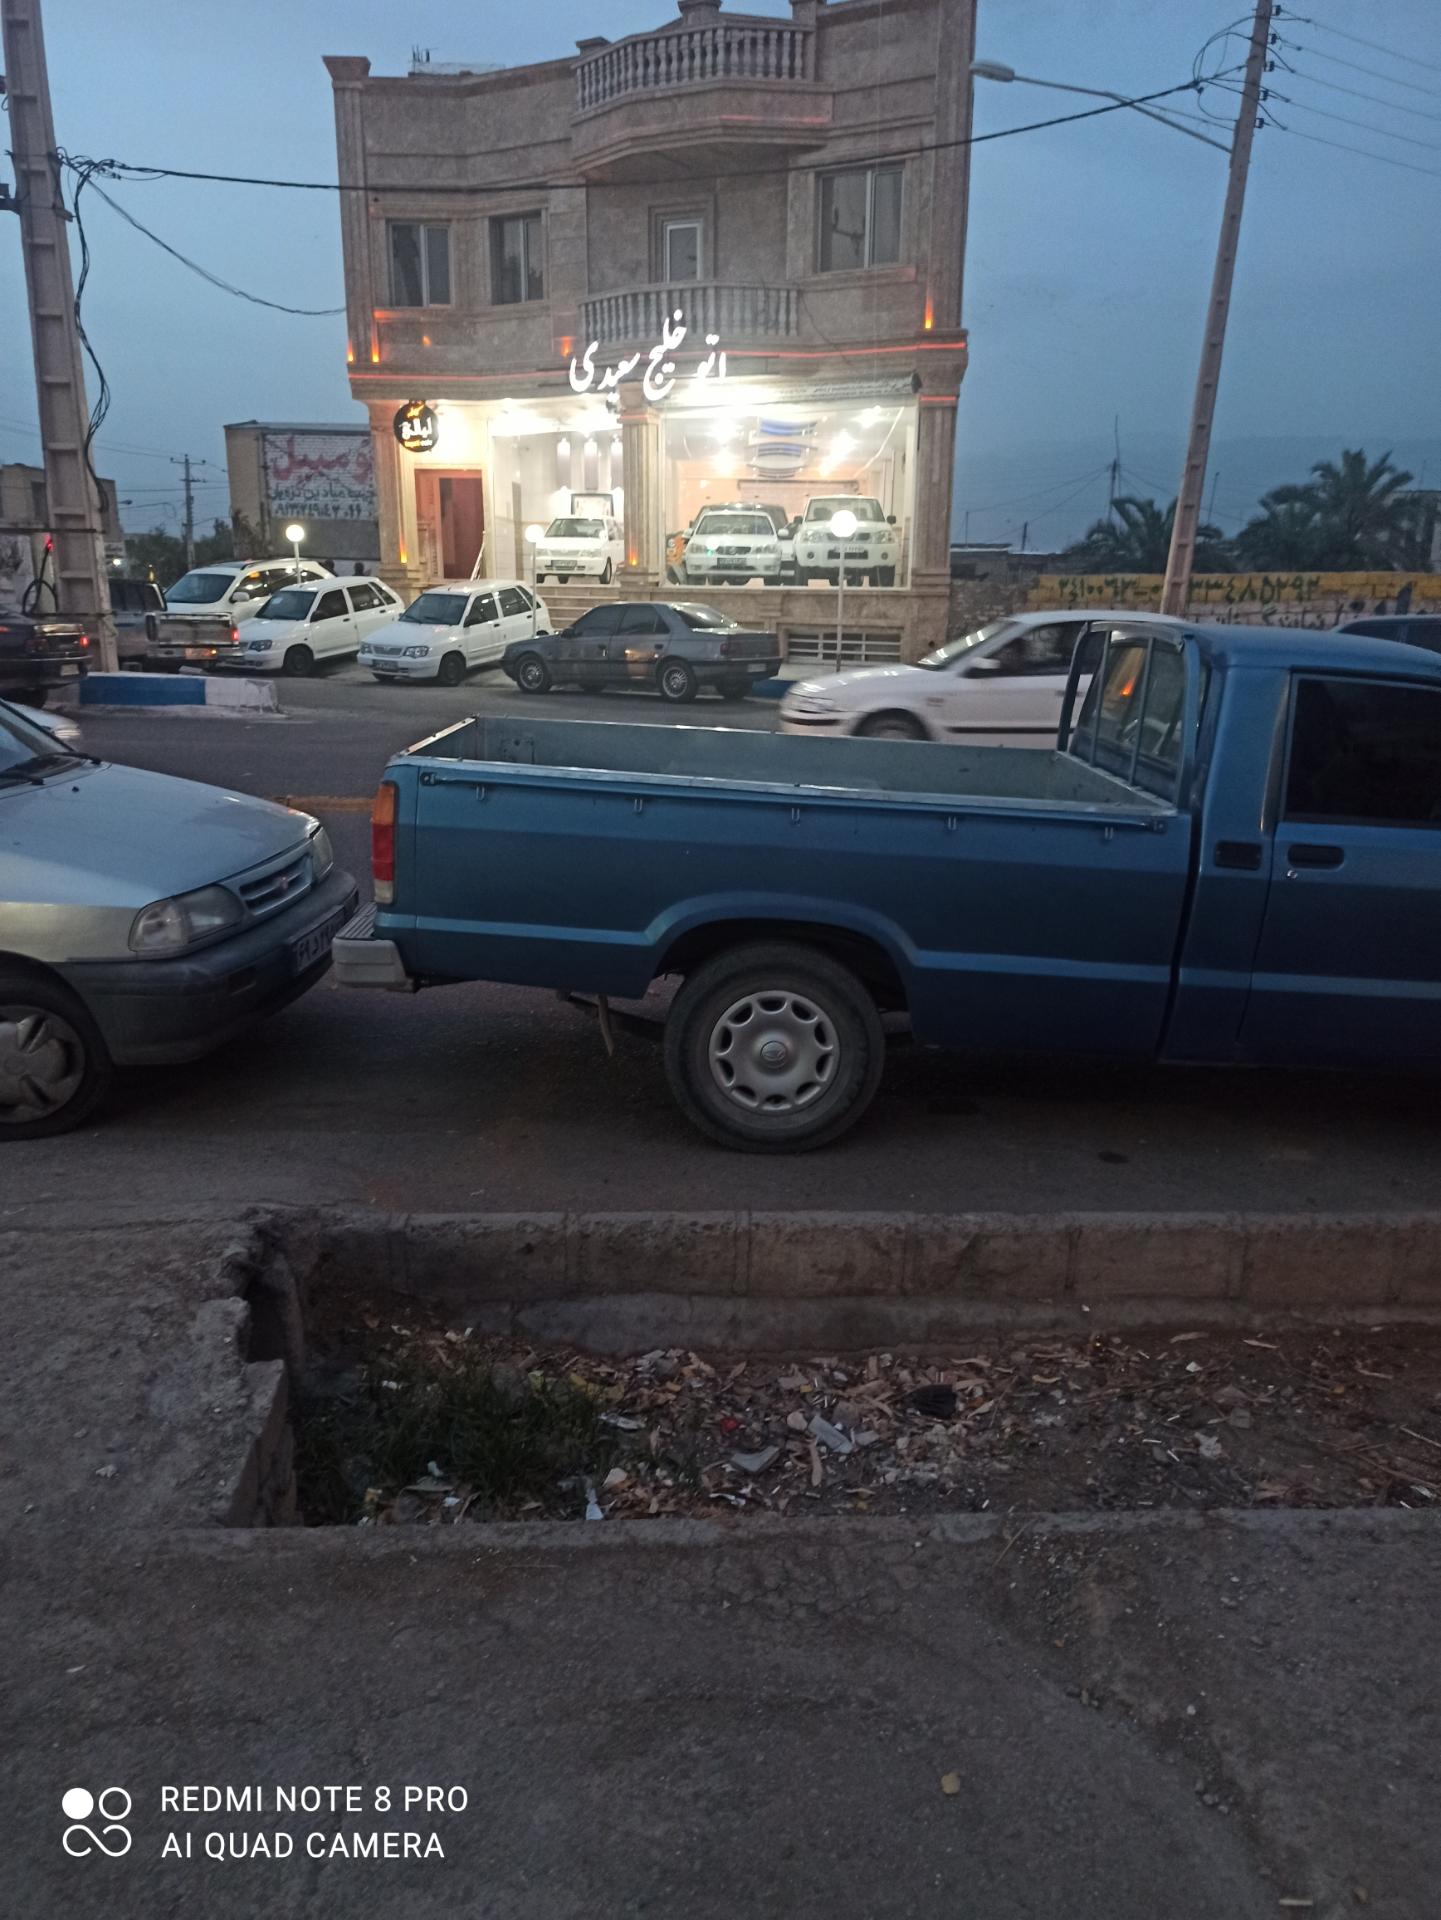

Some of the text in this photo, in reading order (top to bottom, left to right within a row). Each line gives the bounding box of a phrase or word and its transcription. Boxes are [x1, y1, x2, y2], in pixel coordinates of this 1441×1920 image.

[569, 309, 728, 403] اتو خلیج سعیدی
